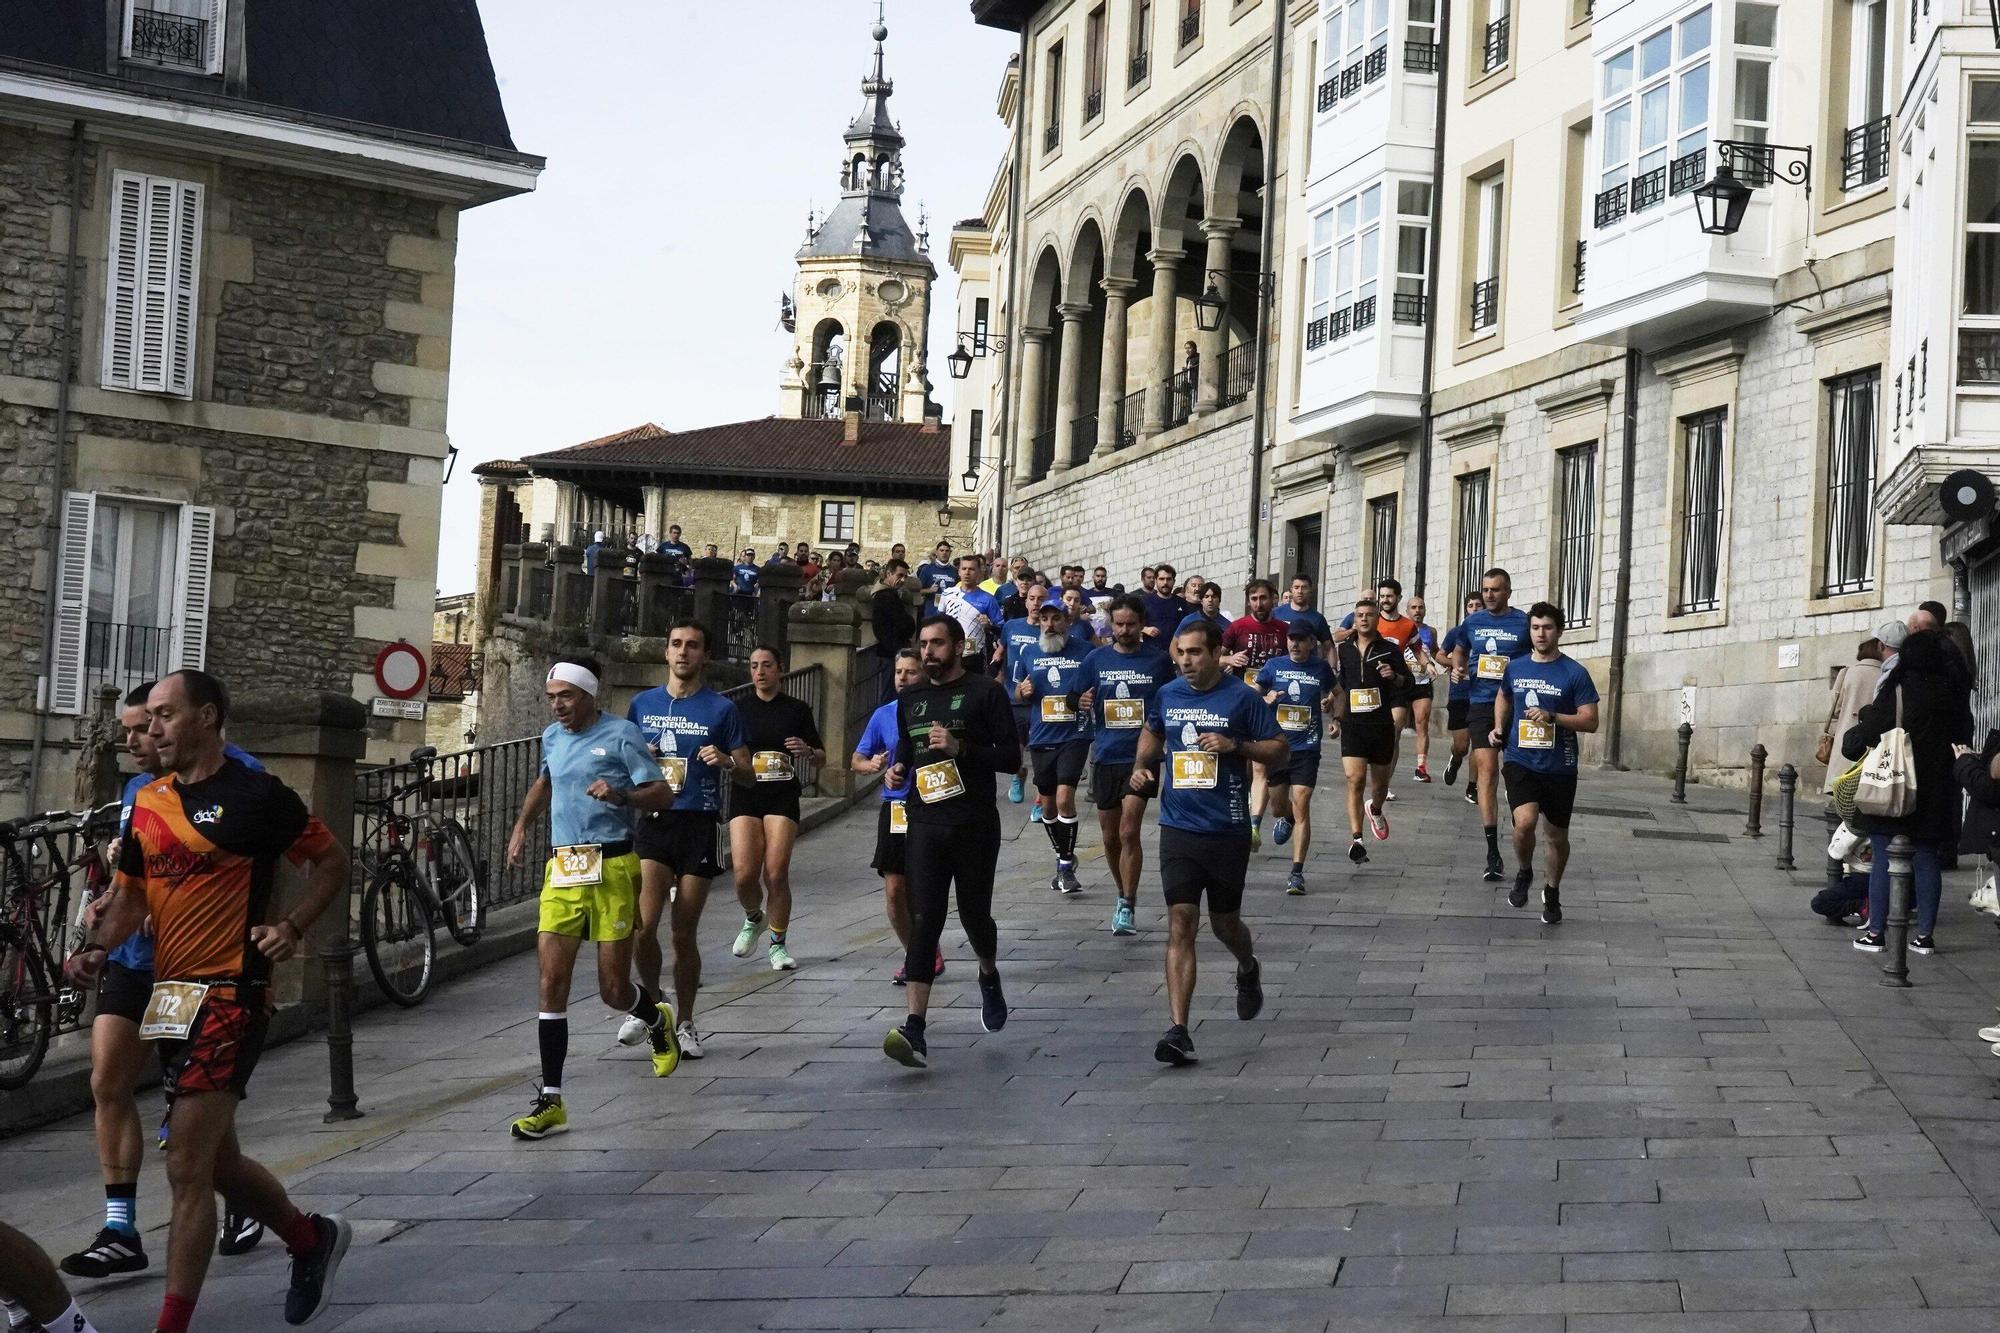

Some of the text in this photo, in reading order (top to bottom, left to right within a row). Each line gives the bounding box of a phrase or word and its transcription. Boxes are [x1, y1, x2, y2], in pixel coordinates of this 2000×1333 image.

[1107, 673, 1146, 681] ALMENDRA
[1053, 701, 1065, 712] 48
[1115, 706, 1133, 718] 160
[1288, 711, 1300, 721] 90
[650, 720, 699, 730] ALMENDRA
[675, 728, 709, 736] KONKISTA
[1526, 727, 1545, 738] 229
[1183, 760, 1203, 775] 180
[924, 770, 948, 789] 252
[563, 854, 588, 872] 523
